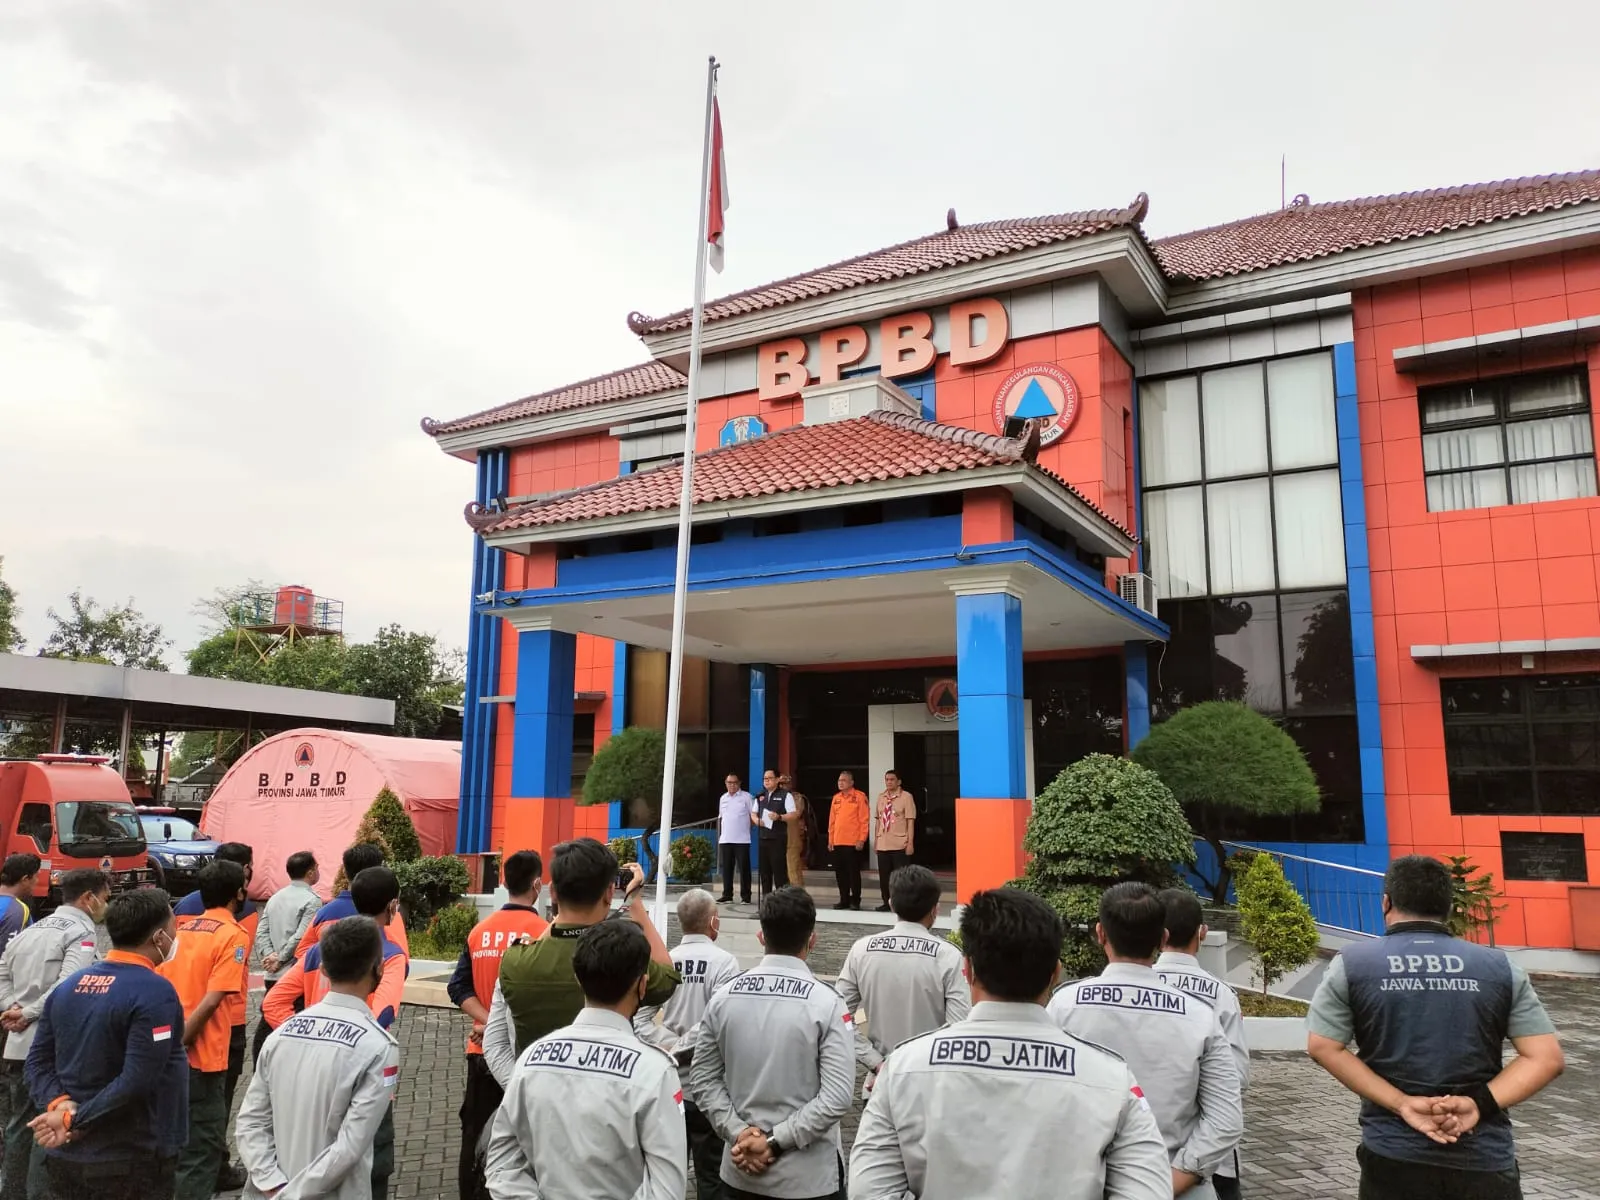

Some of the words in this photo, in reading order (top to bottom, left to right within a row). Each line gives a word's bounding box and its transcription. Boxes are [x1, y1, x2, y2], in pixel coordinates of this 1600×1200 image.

[759, 297, 1010, 400] BPBD
[1040, 428, 1059, 443] MUR
[258, 771, 347, 787] BPBD
[258, 788, 294, 798] PROVINSI
[296, 788, 318, 798] JAWA
[320, 787, 346, 797] TIMUR
[870, 938, 896, 950] BPBD
[901, 939, 934, 953] JATIM
[674, 960, 707, 975] PBD
[1387, 954, 1464, 973] BPBD
[78, 975, 116, 986] BPBD
[733, 977, 765, 991] BPBD
[769, 978, 809, 995] JATIM
[1172, 975, 1214, 995] JATIM
[1380, 978, 1425, 991] JAWA
[1425, 977, 1480, 992] TIMUR
[74, 986, 109, 994] JATIM
[1081, 986, 1123, 1002] BPBD
[1131, 989, 1180, 1010] JATIM
[285, 1019, 316, 1035] BPBD
[318, 1021, 361, 1042] JATIM
[530, 1042, 573, 1063] BPBD
[578, 1045, 633, 1073] JATIM
[937, 1040, 991, 1063] BPBD
[1002, 1043, 1067, 1070] JATIM
